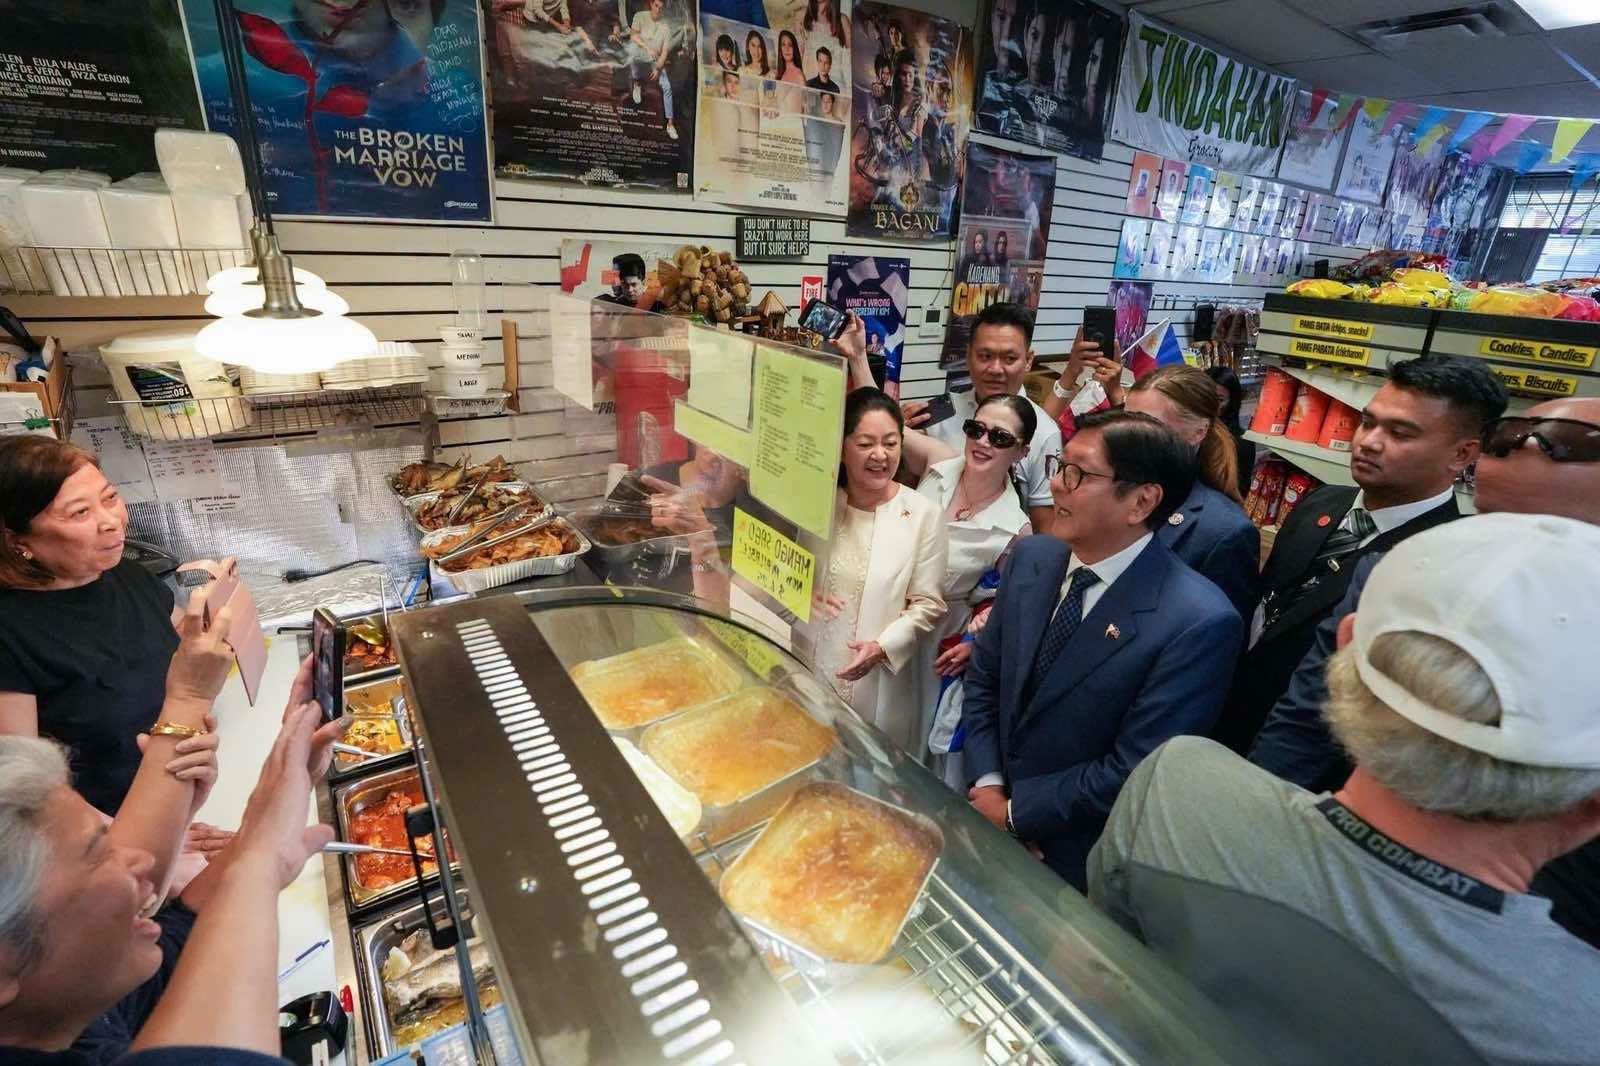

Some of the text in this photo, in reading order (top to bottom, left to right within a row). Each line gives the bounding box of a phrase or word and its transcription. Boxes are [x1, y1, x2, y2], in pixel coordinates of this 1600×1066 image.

[5, 63, 62, 77] JC DE VERA
[32, 57, 97, 73] EULA VALDES
[26, 74, 72, 87] SORIANO
[70, 70, 130, 84] RYZA CENON
[1135, 24, 1290, 149] TINDAHAN
[335, 127, 465, 153] THE BROKEN
[334, 145, 467, 172] MARRIAGE
[373, 167, 437, 188] VOW
[744, 218, 809, 230] YOU DON'T HAVE TO BE
[874, 210, 940, 232] BAGANI
[743, 230, 809, 241] CRAZY TO WORK HERE
[743, 242, 809, 256] BUT IT SURE HELPS
[967, 264, 1000, 283] KADENANG
[1300, 319, 1315, 330] PANG
[1539, 345, 1588, 362] Candies
[1524, 374, 1570, 392] Biscuits
[1327, 807, 1480, 896] PRO COMBAT
